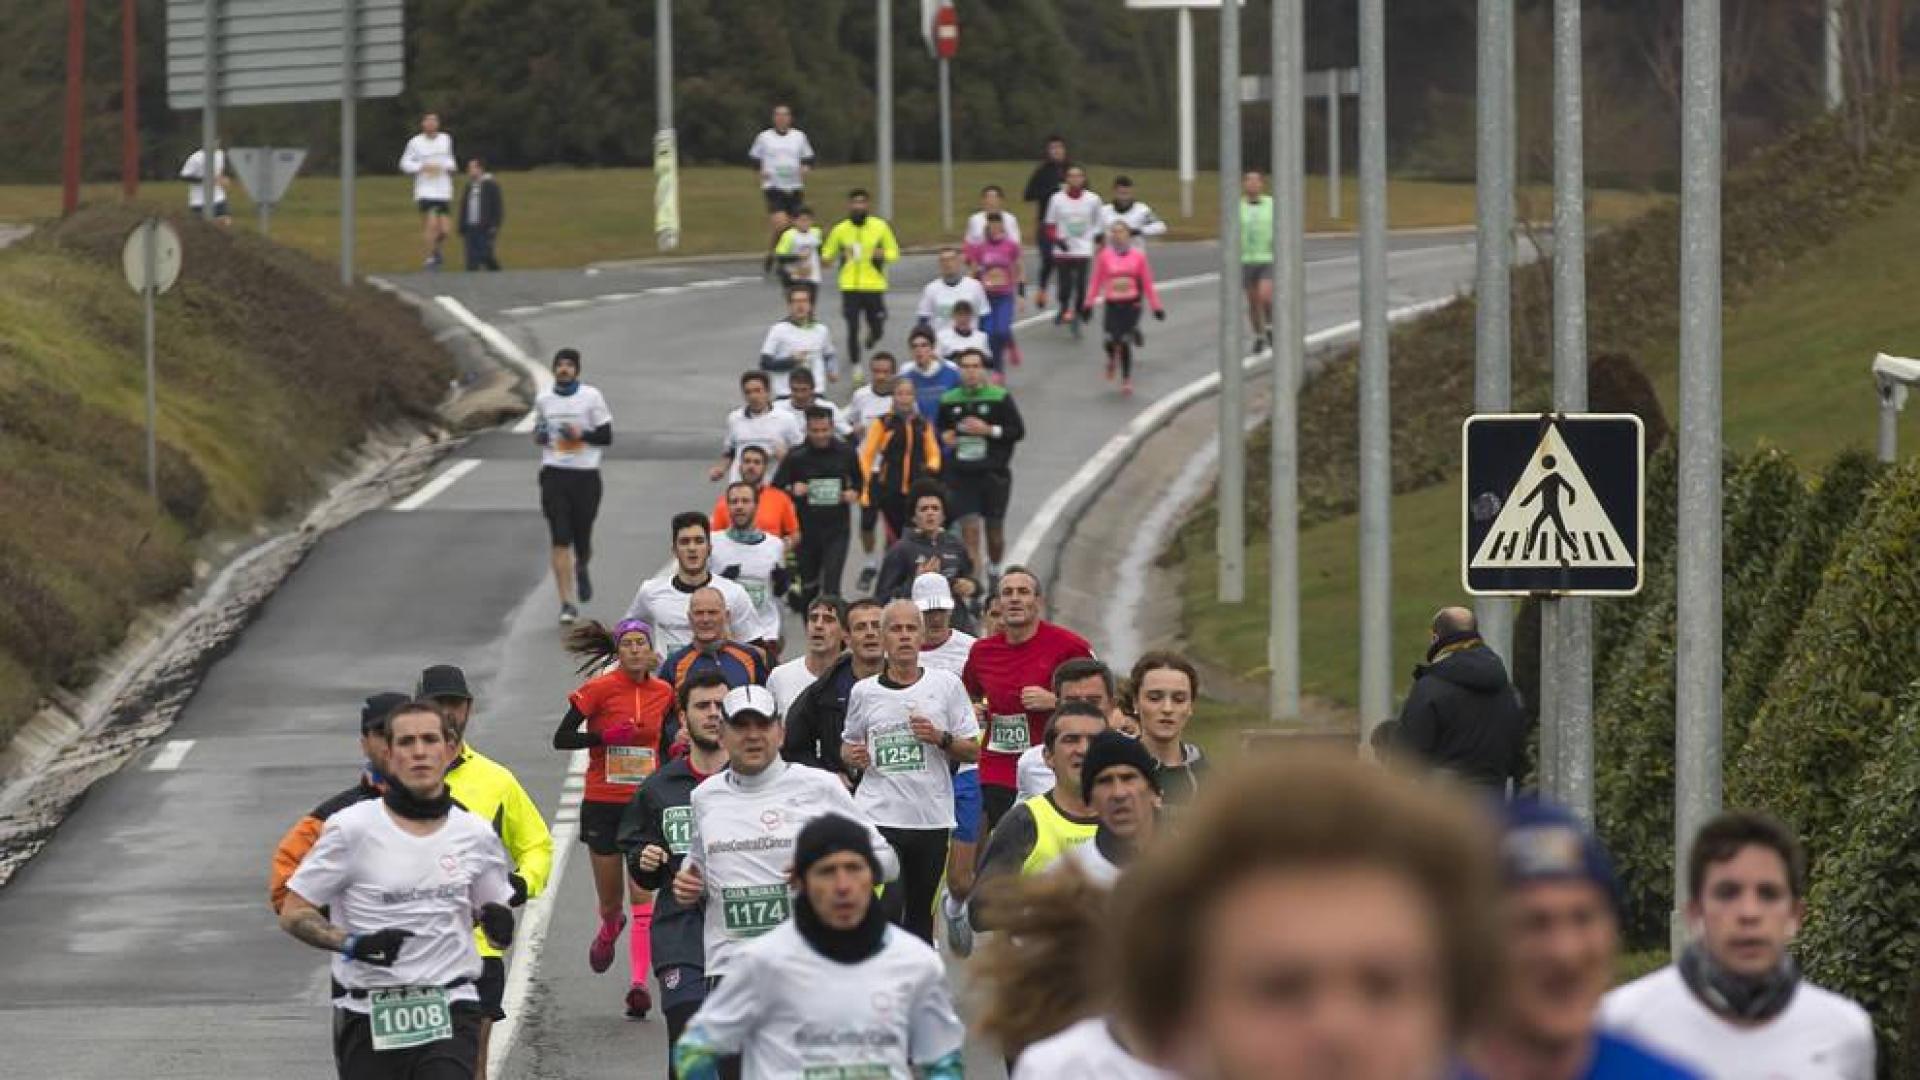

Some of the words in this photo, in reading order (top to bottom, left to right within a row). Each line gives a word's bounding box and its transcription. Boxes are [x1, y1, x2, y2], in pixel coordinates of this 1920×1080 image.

[879, 746, 921, 764] 1254
[668, 822, 690, 841] 11
[729, 900, 785, 925] 1174
[378, 1004, 444, 1032] 1008
